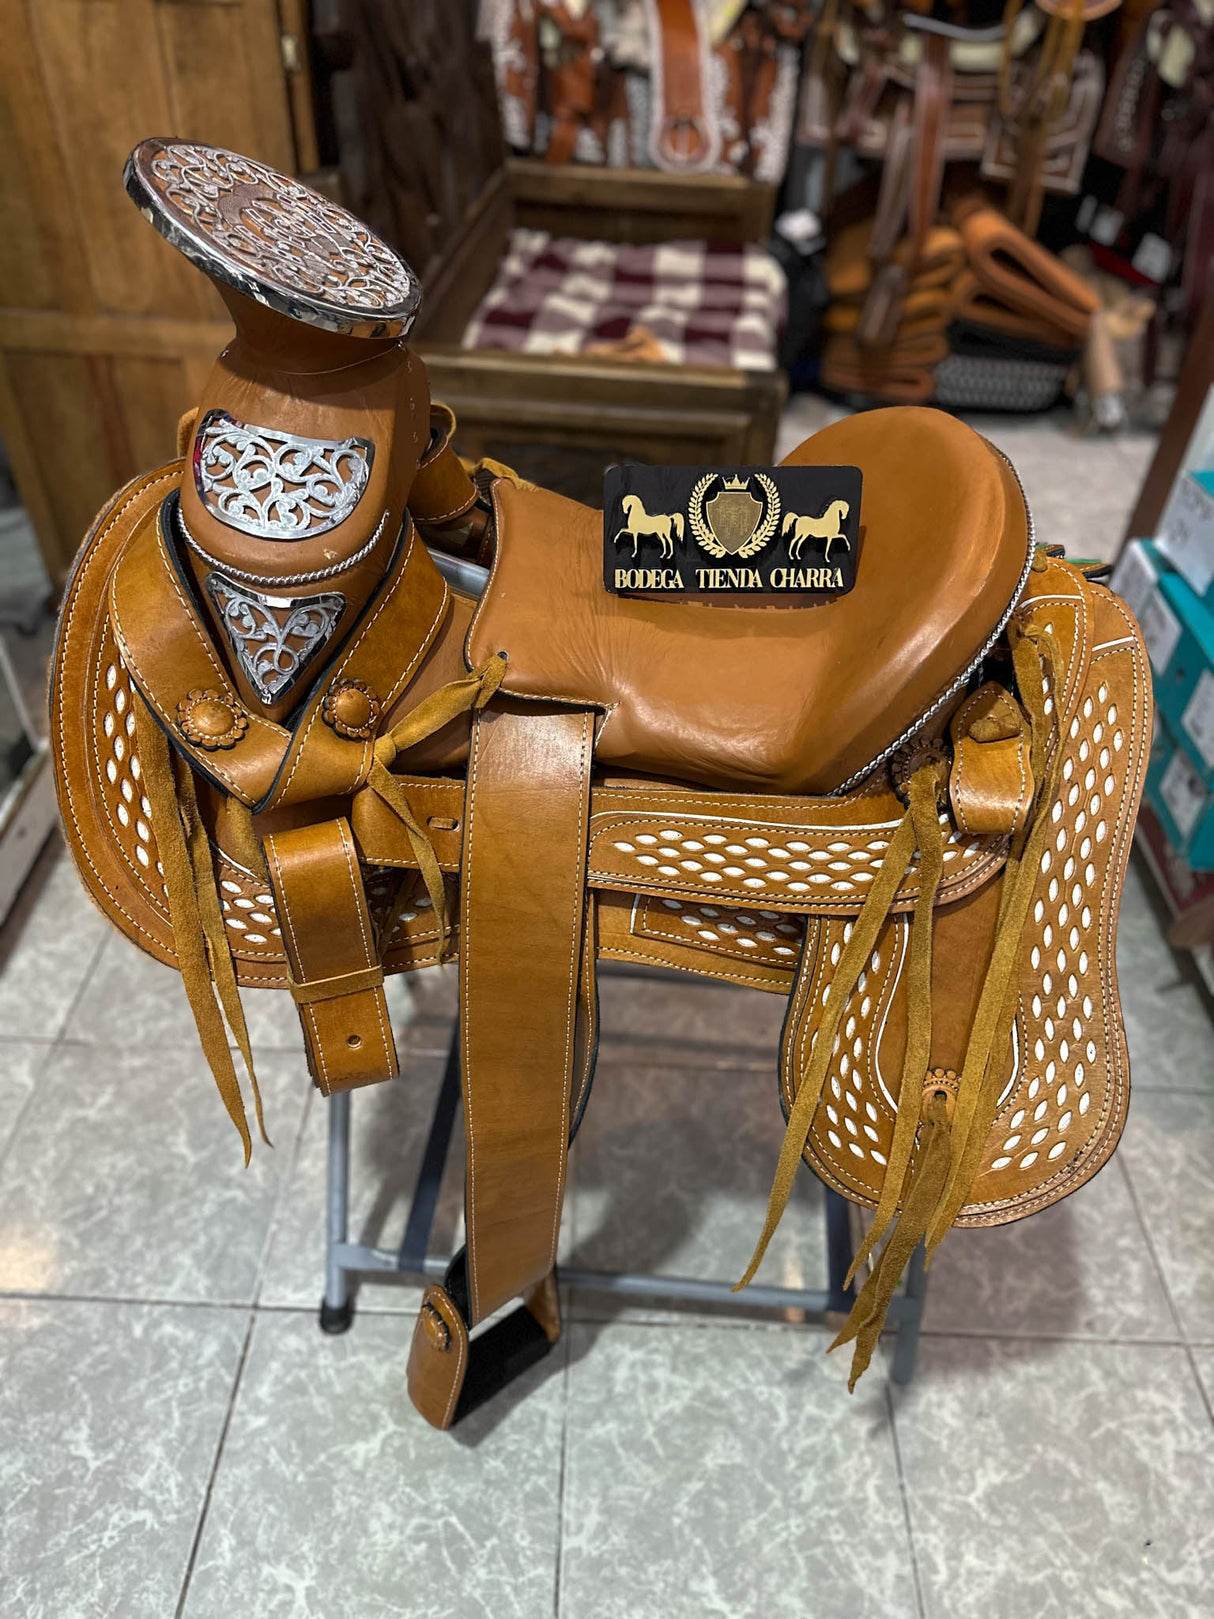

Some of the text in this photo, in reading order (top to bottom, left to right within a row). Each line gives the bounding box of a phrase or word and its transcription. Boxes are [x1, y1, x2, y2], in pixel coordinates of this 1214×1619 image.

[614, 567, 844, 589] BODEGA TIENDA CHARRA
